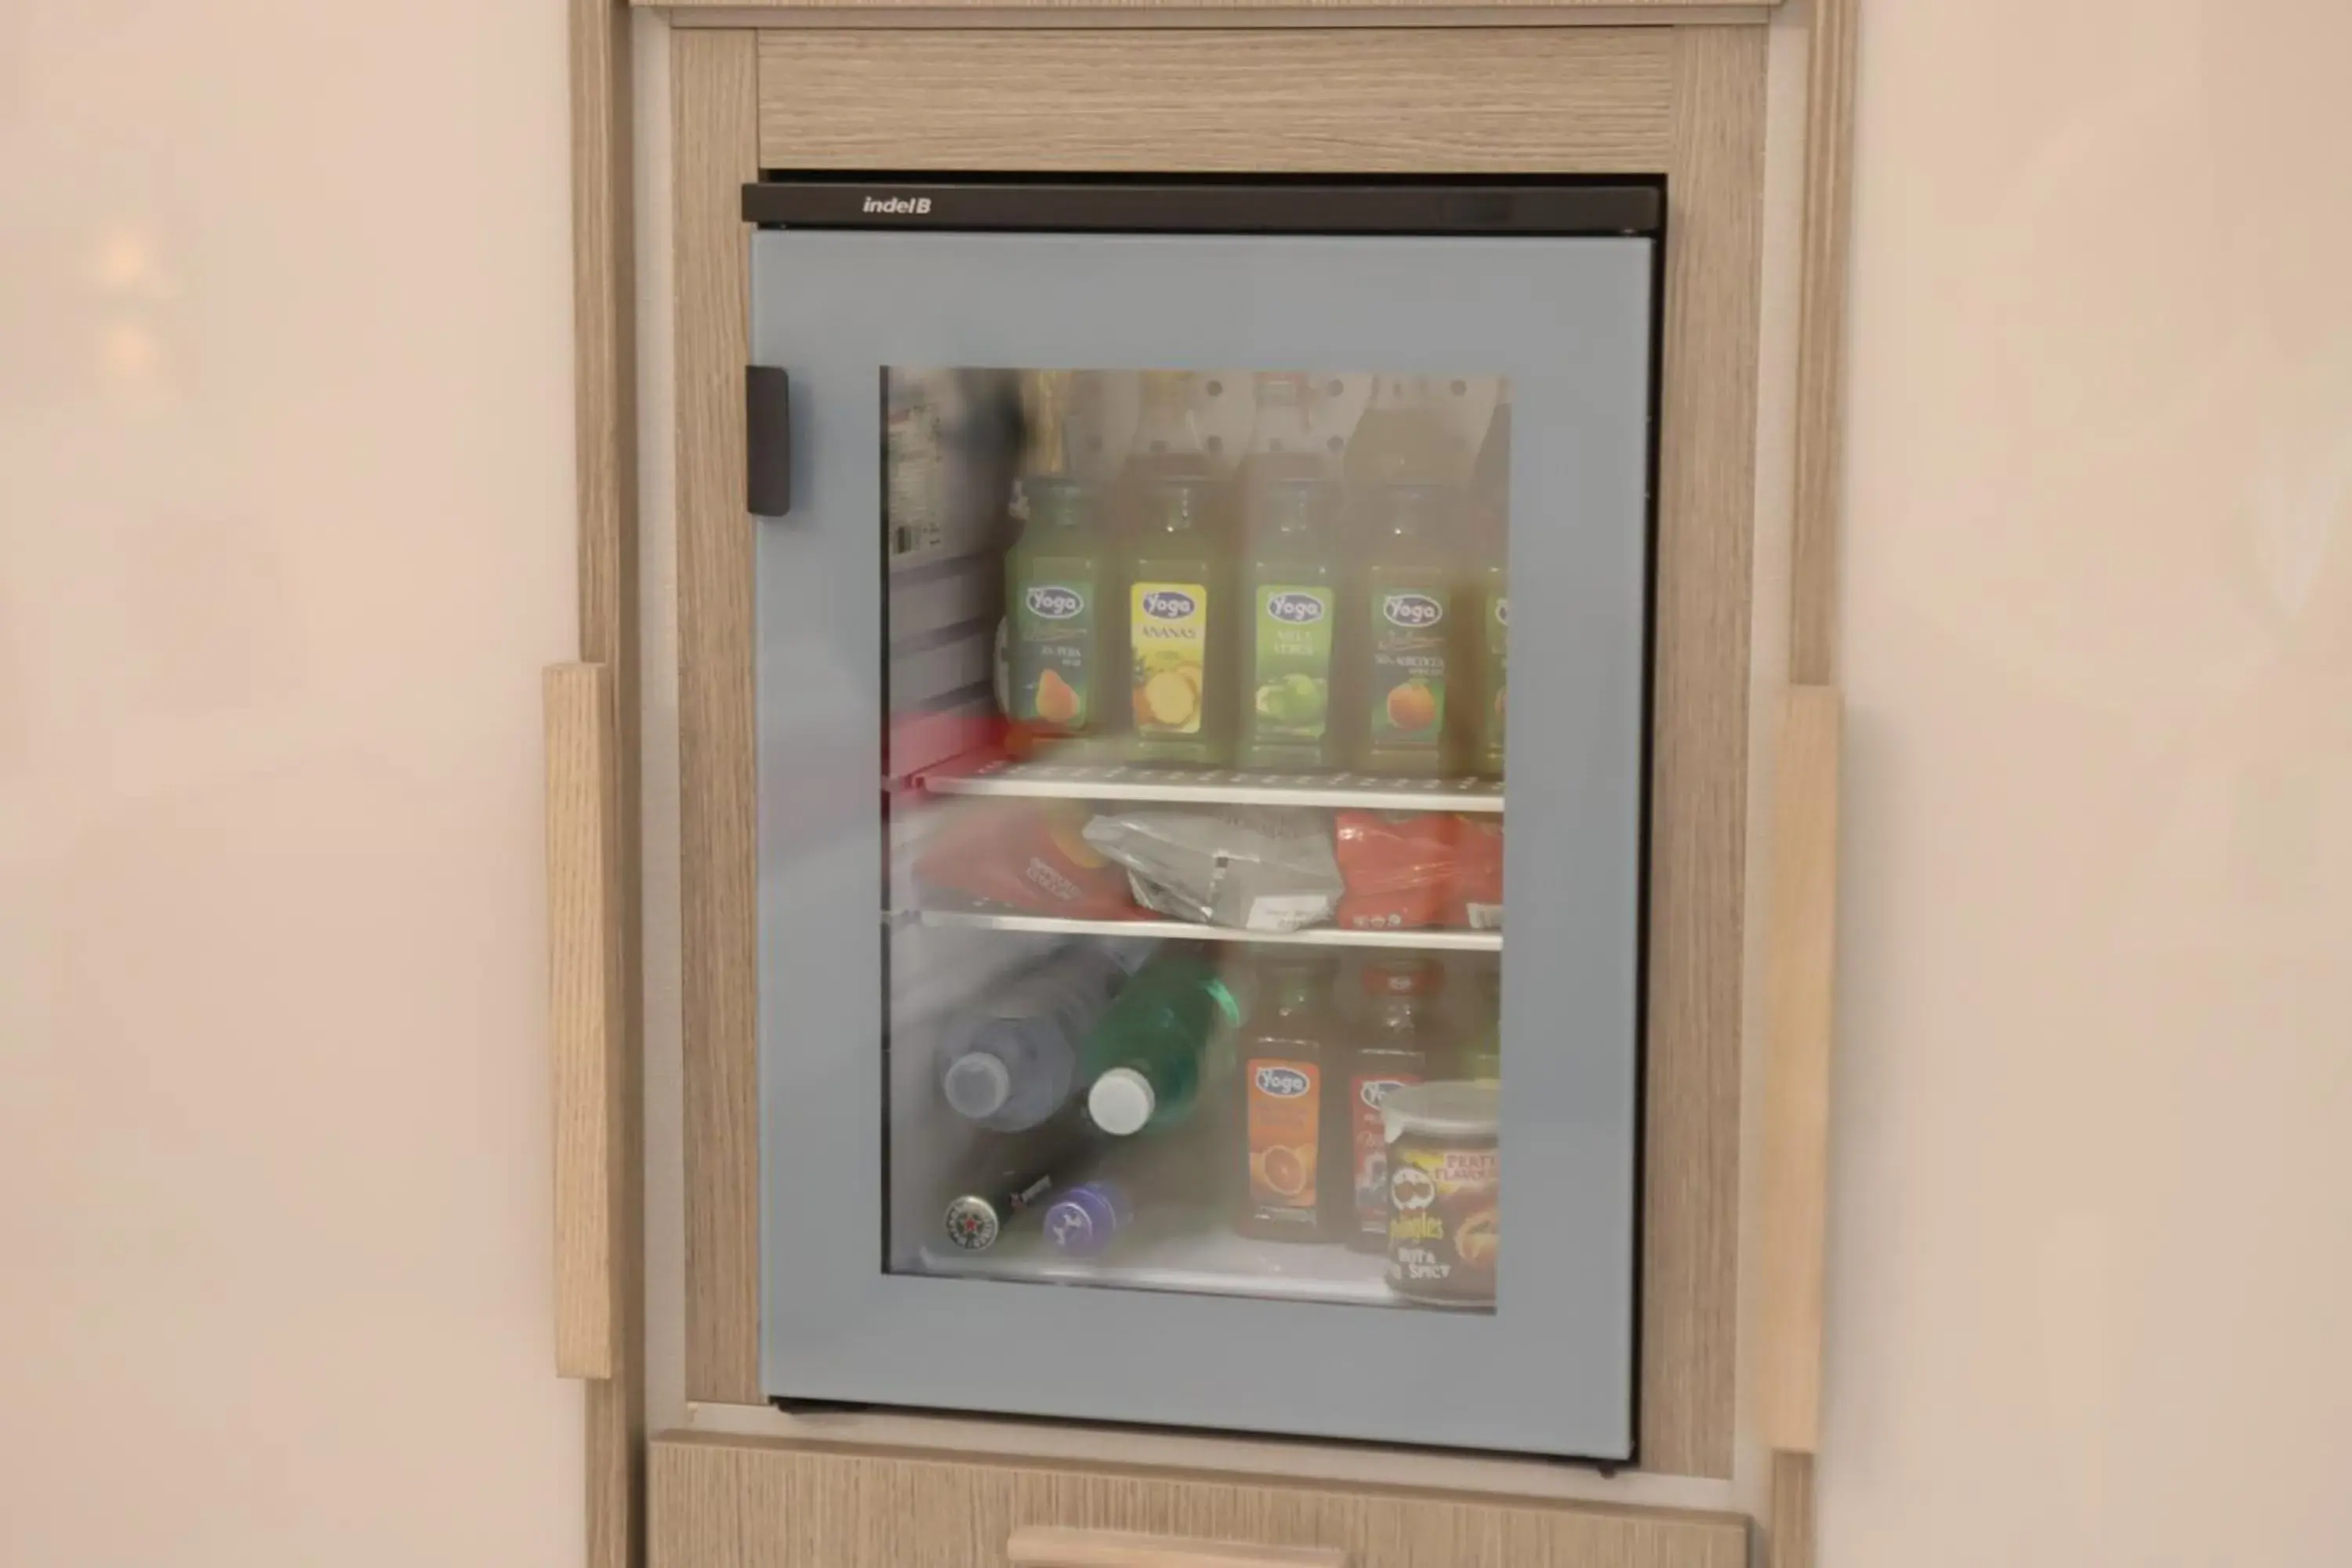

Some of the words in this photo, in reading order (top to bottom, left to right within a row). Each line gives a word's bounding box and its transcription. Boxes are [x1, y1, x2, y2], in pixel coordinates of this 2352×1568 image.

[1029, 588, 1077, 614] Yoga
[1145, 592, 1192, 618] Yoga
[1269, 593, 1319, 620] Yoga
[1385, 595, 1436, 622] Yoga
[1257, 1068, 1304, 1095] Yoga
[1409, 1263, 1451, 1279] SPICY
